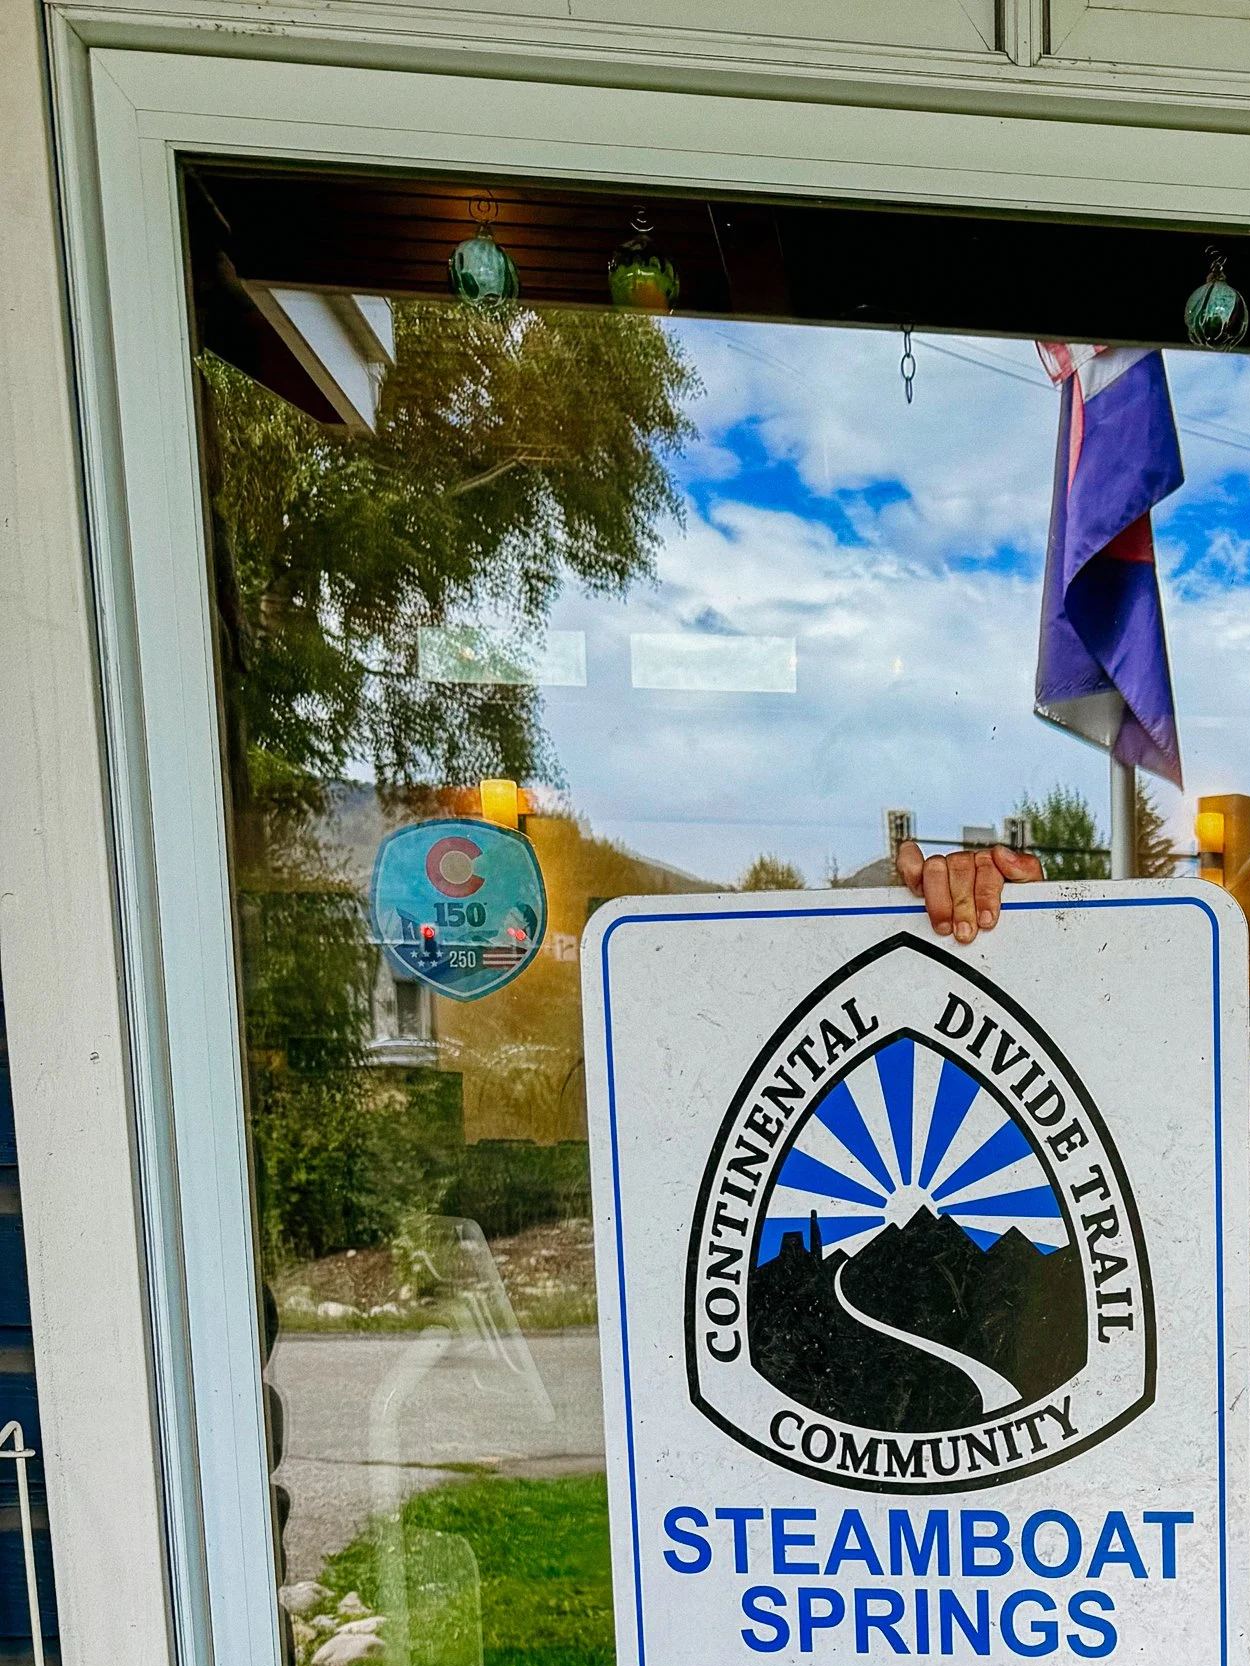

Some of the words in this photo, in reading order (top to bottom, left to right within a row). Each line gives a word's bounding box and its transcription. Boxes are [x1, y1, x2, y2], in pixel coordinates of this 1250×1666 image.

[449, 950, 477, 968] 250
[705, 996, 879, 1363] CONTINENTAL
[933, 991, 1090, 1163] DIVIDE
[1069, 1163, 1134, 1344] TRAIL
[769, 1394, 1079, 1479] COMMUNITY
[662, 1505, 1196, 1580] STEAMBOAT
[740, 1585, 1119, 1659] SPRINGS
